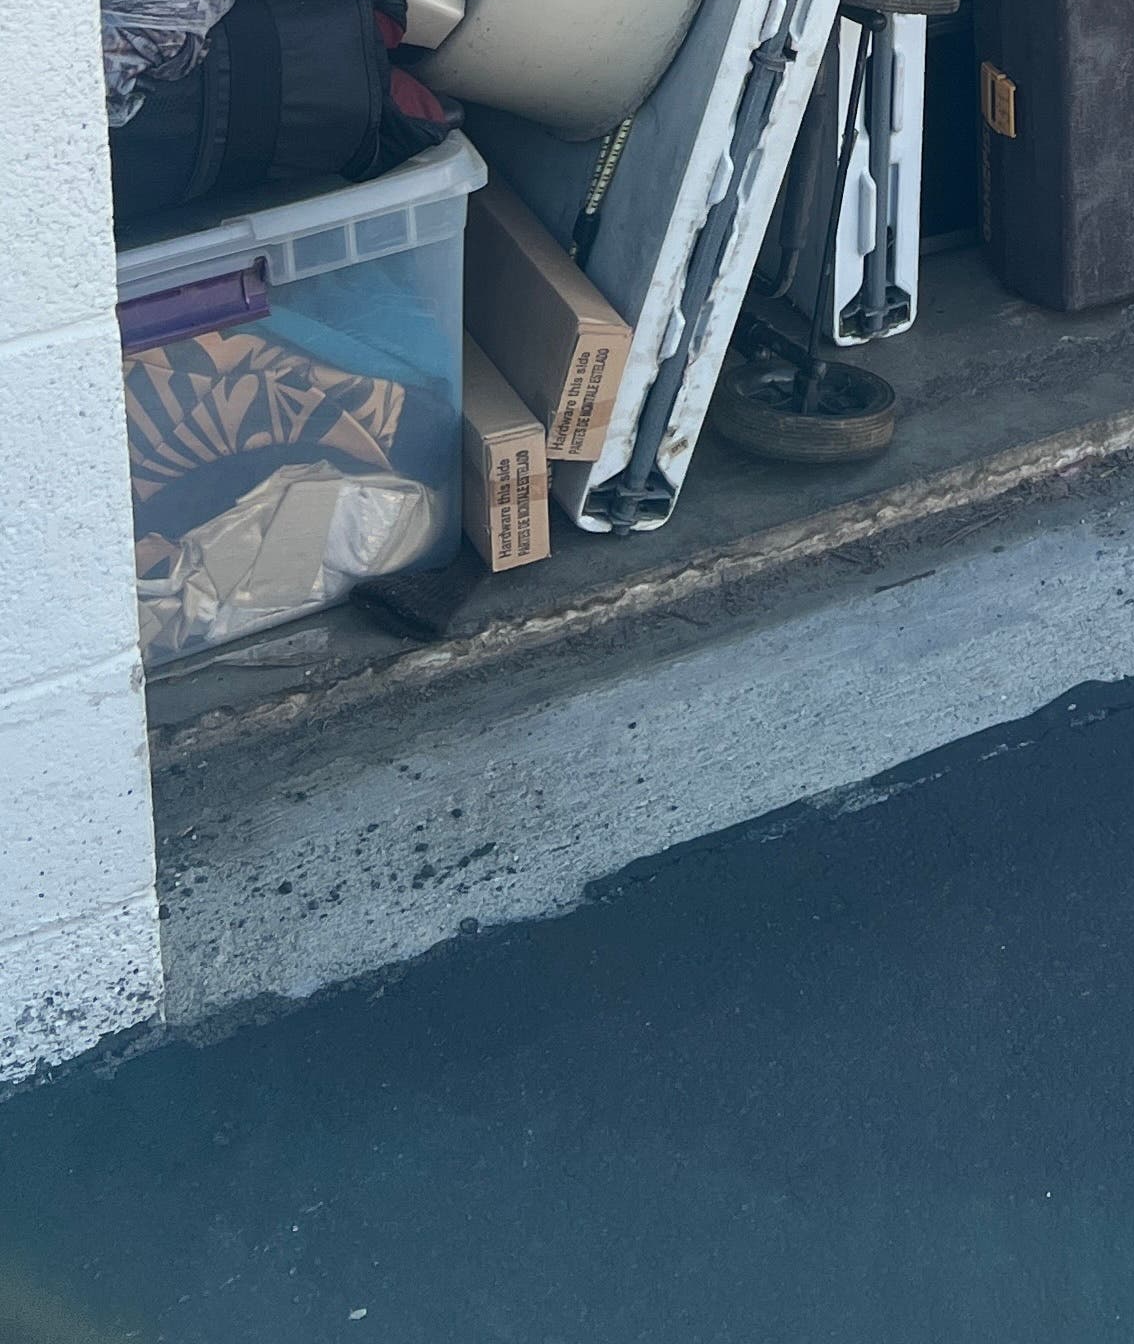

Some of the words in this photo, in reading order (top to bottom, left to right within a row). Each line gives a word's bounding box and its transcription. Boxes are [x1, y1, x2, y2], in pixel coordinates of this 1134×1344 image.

[550, 399, 577, 451] Hardware
[567, 377, 583, 397] this
[576, 351, 590, 375] side
[568, 427, 587, 455] PARTES
[497, 458, 511, 482] side
[497, 483, 511, 505] this
[498, 506, 512, 560] Hardware
